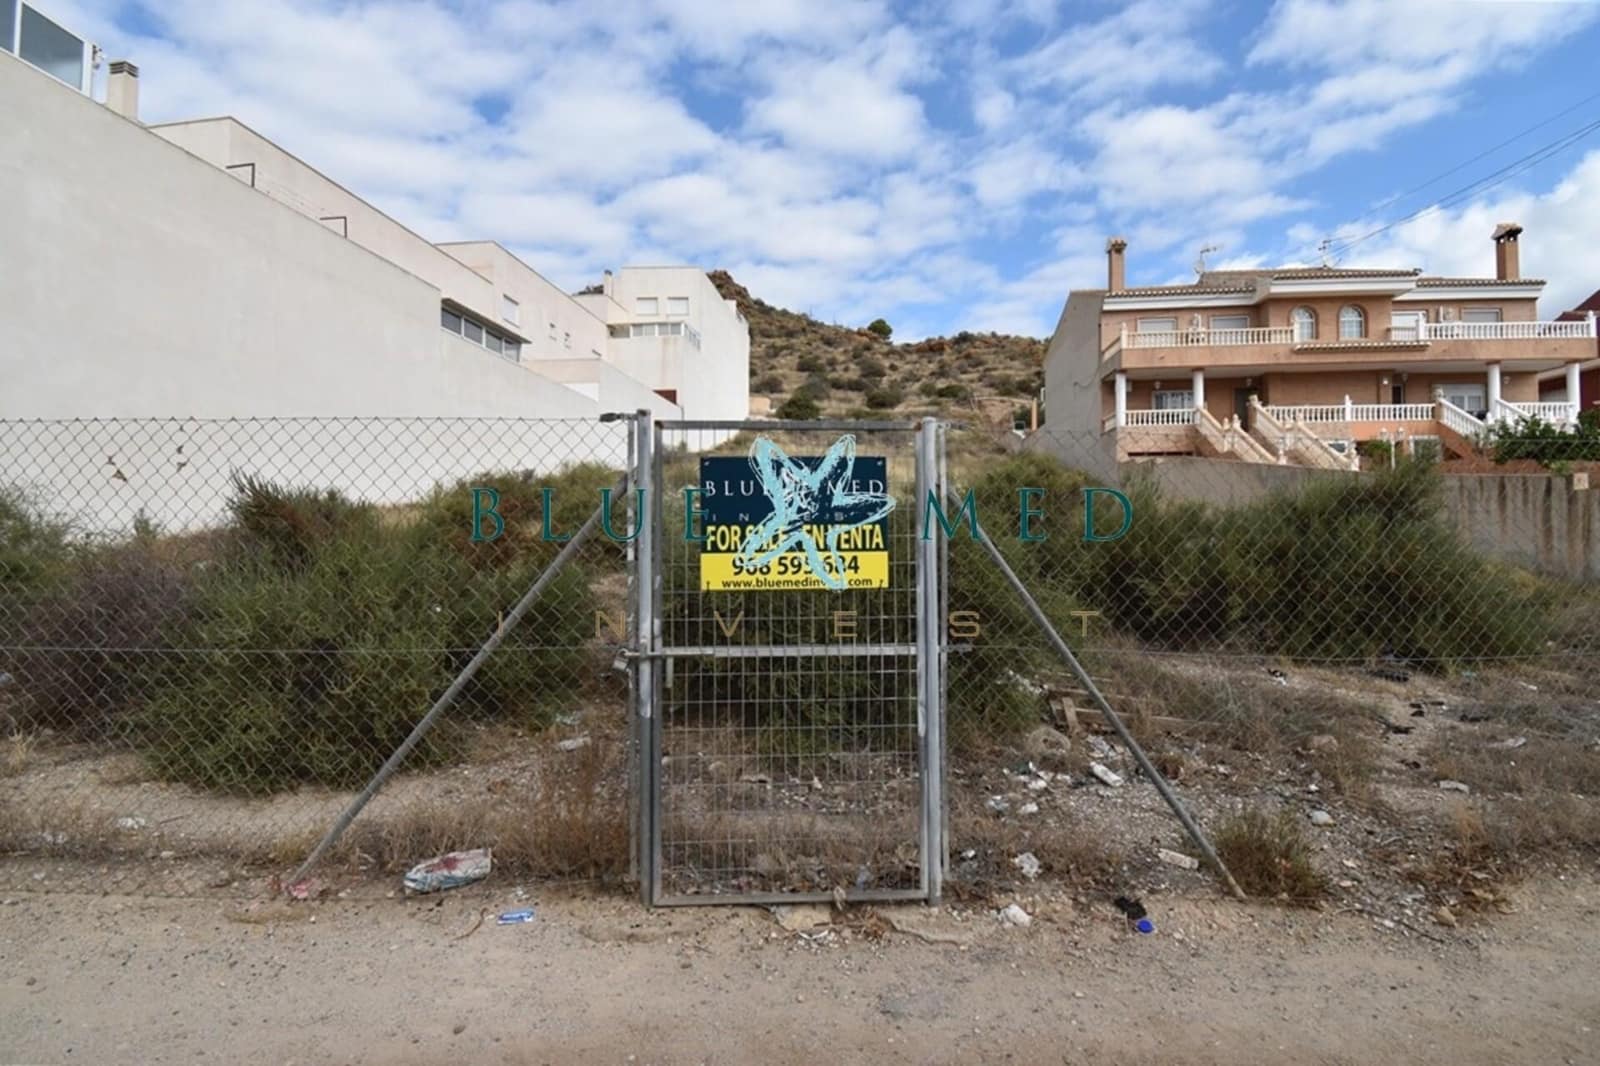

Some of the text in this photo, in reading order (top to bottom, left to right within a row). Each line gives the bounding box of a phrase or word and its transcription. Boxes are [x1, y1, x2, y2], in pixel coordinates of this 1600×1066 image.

[706, 525, 742, 551] FOR
[828, 524, 884, 550] ENTA
[721, 577, 873, 590] www.bluemedinvcom
